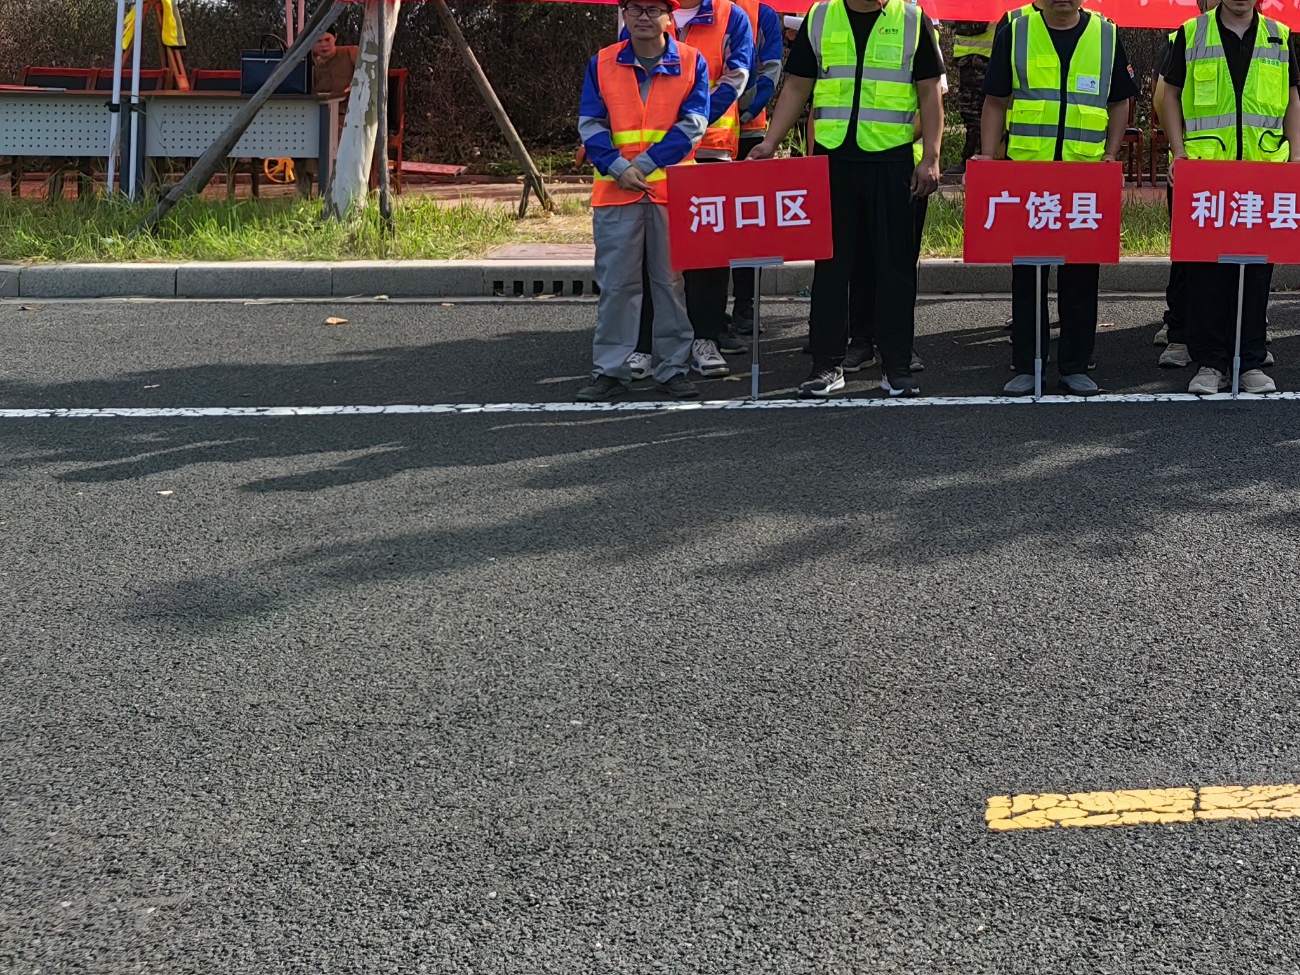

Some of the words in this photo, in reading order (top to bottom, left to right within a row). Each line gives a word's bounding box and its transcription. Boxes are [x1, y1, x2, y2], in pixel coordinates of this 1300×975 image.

[689, 190, 811, 233] 河口区
[984, 191, 1102, 230] 广饶县
